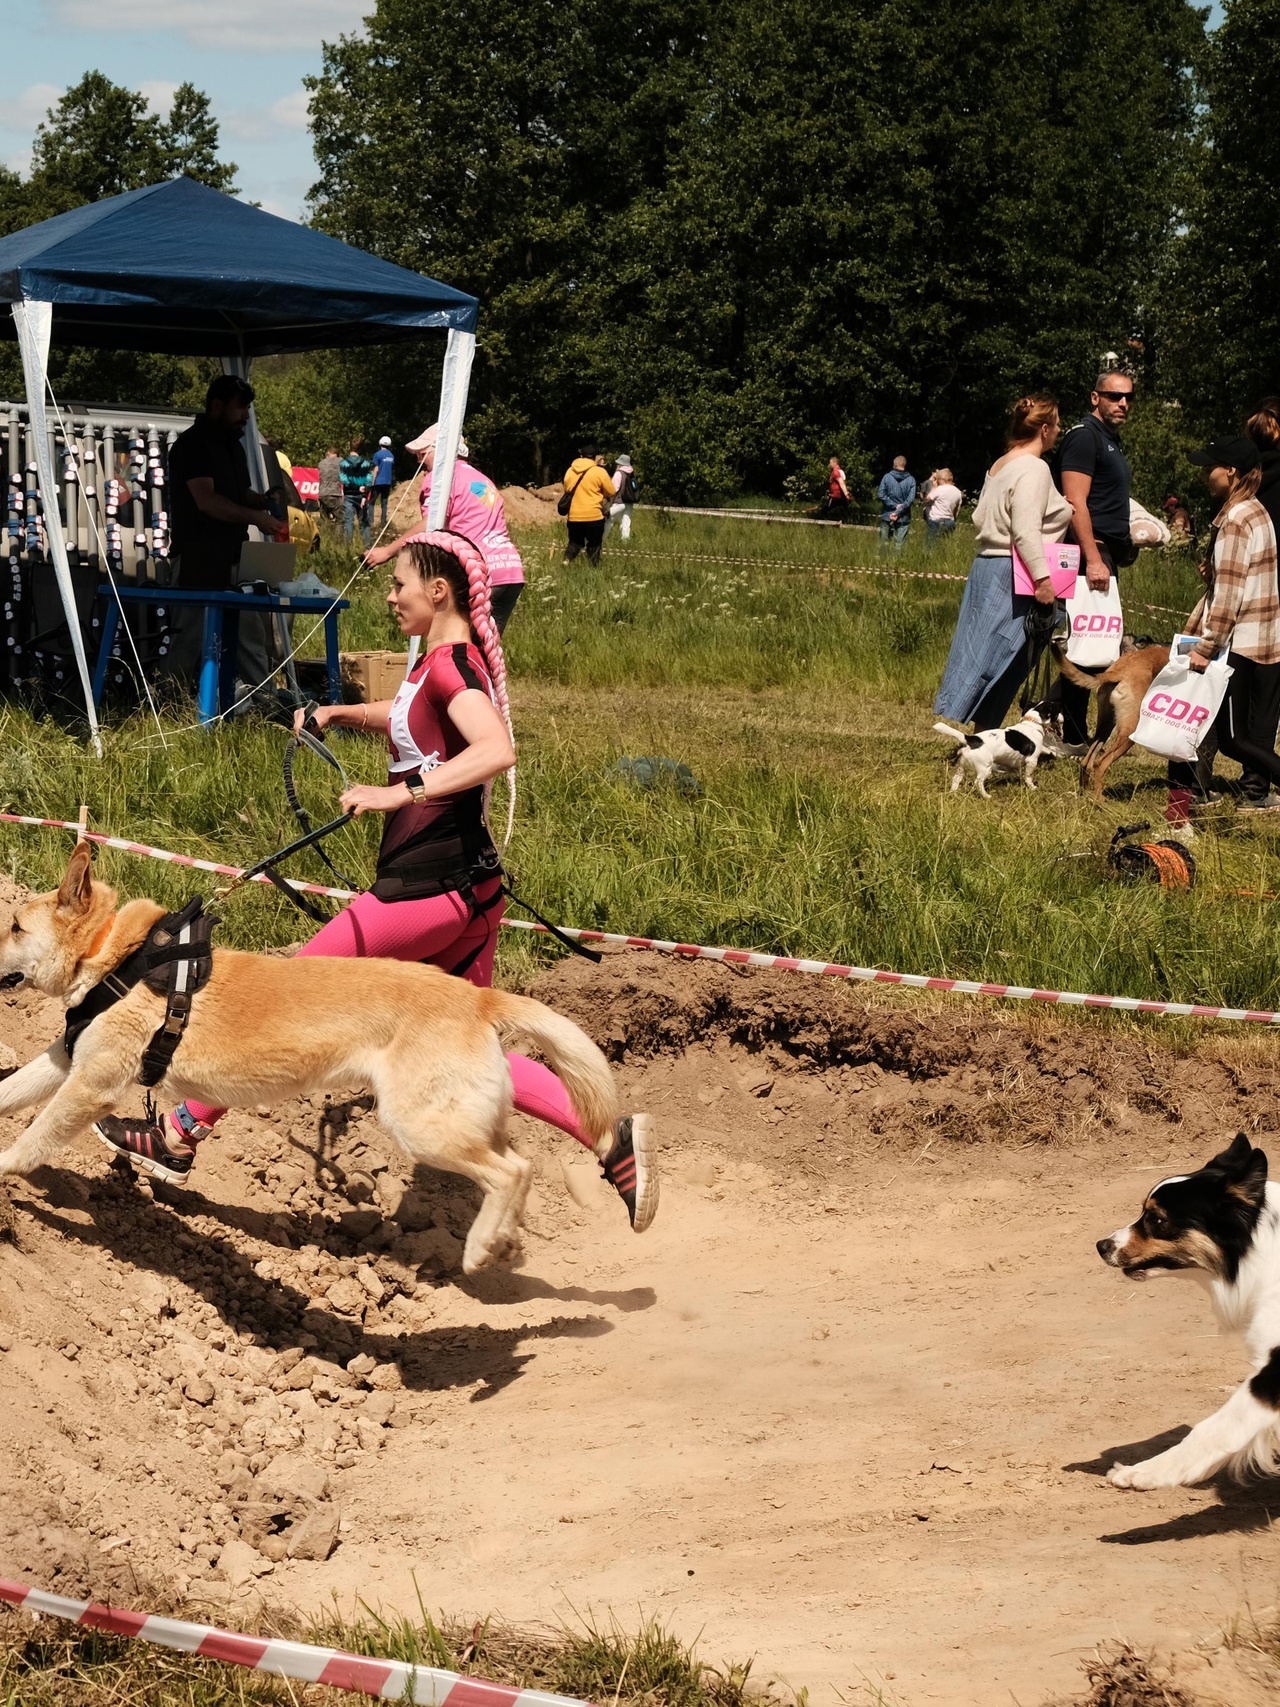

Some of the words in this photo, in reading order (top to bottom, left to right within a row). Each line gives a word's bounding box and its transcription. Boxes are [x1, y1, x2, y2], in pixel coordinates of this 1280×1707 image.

[300, 481, 320, 495] DO
[1072, 614, 1122, 633] CDR
[1141, 710, 1166, 723] CRAZY
[1164, 718, 1181, 728] DOG
[1148, 693, 1210, 727] CDR
